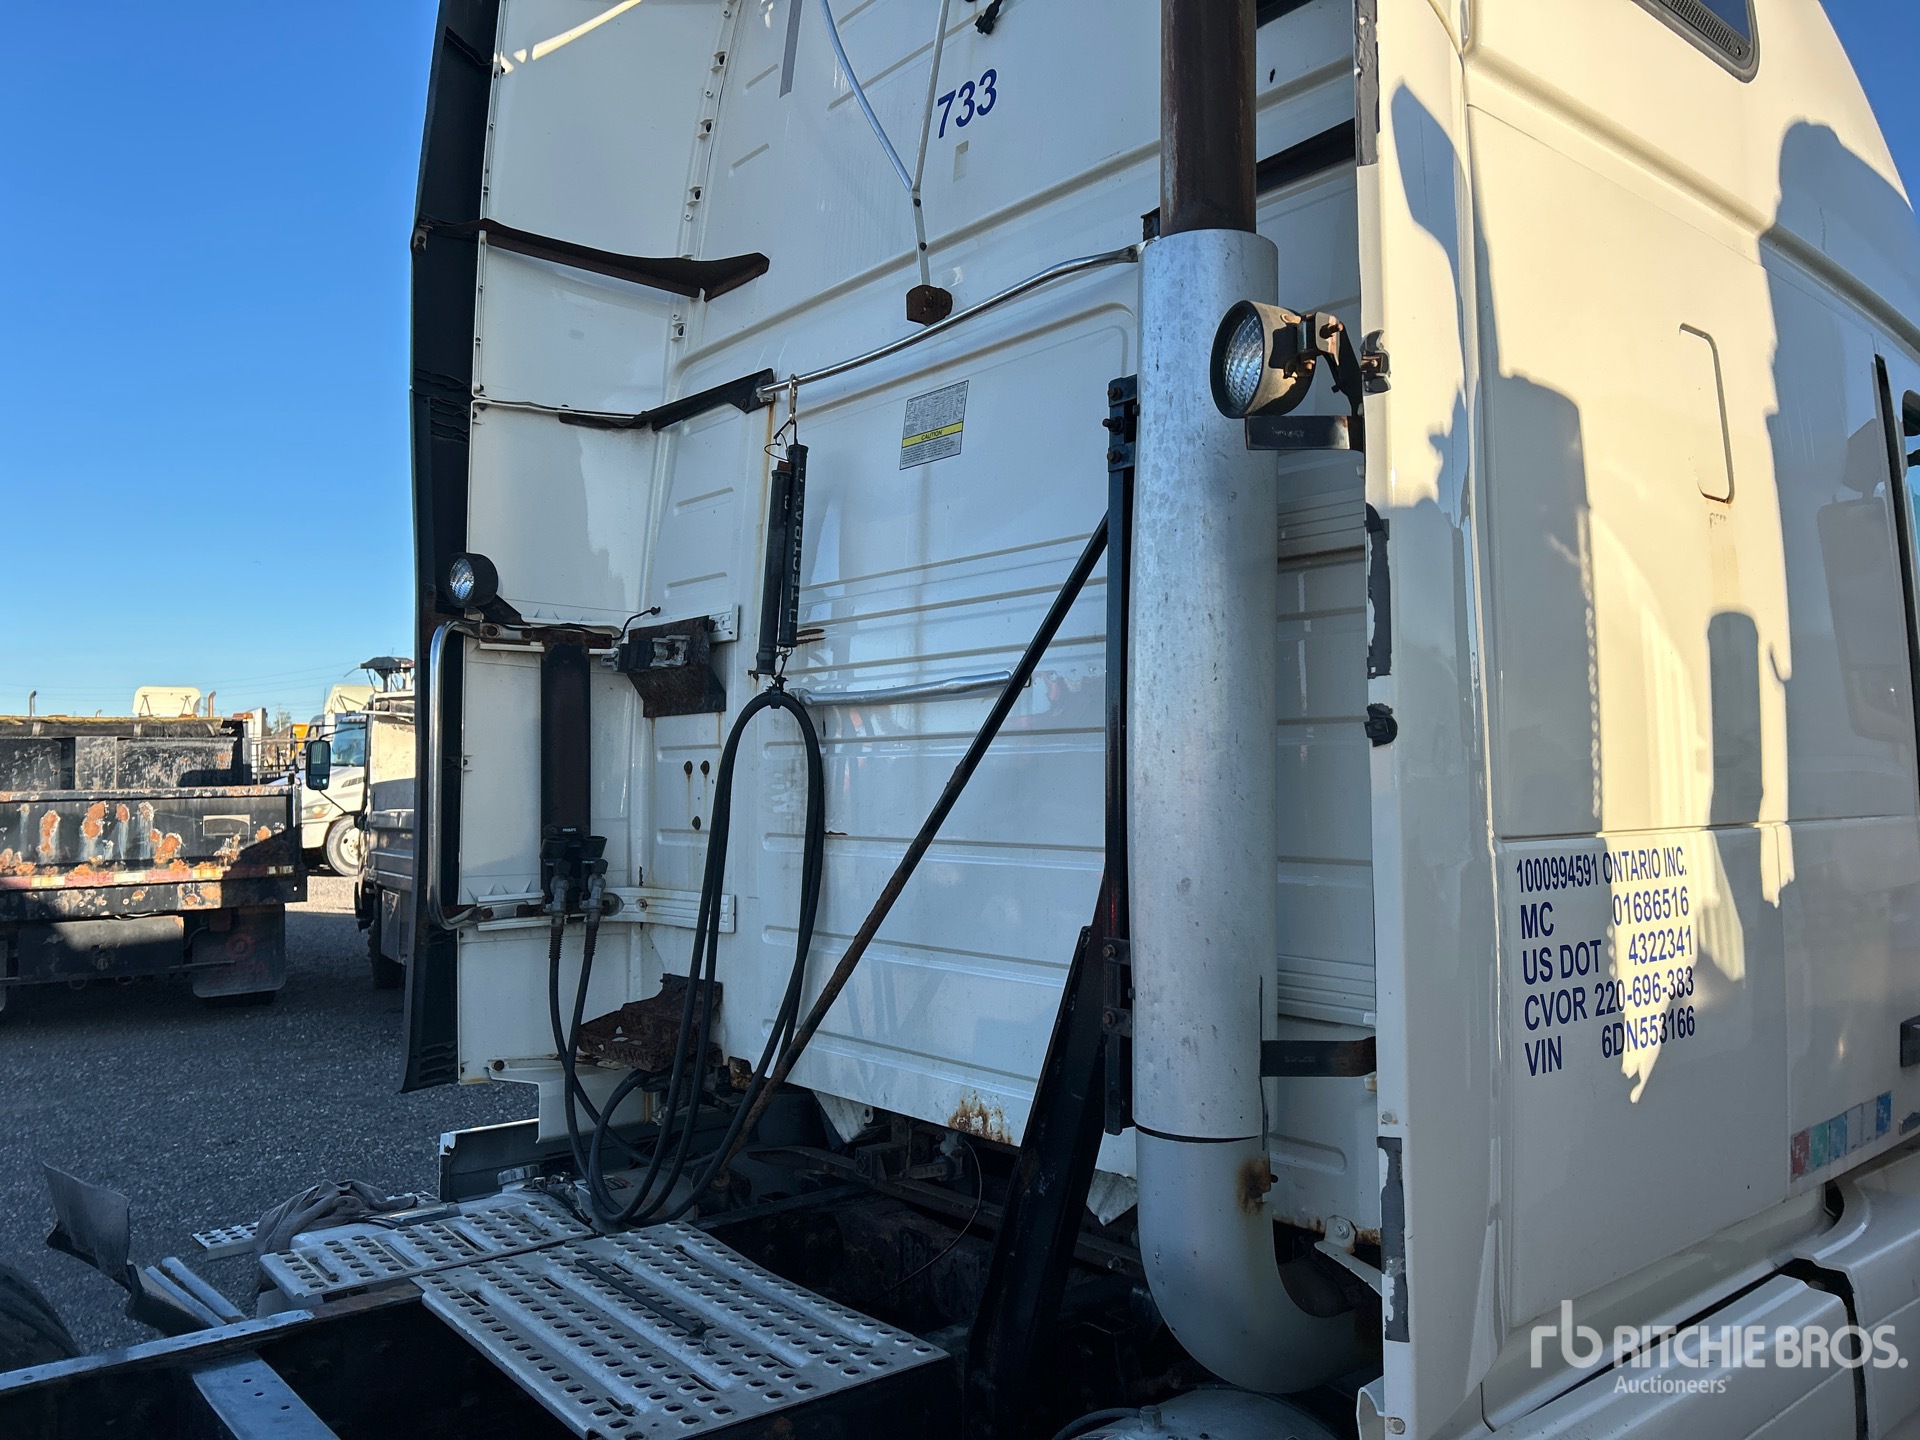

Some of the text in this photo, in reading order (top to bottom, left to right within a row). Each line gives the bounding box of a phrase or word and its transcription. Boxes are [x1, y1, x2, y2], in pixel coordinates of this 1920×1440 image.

[937, 68, 997, 139] 733
[920, 430, 943, 440] CAUTION
[1516, 846, 1687, 893] 1000994591 ONTARIO INC.
[1520, 886, 1689, 939] MC 01686516
[1522, 925, 1693, 985] US DOT 4322341
[1524, 965, 1694, 1031] CVOR 220-696-383
[1524, 1005, 1695, 1076] VIN 6DN553166
